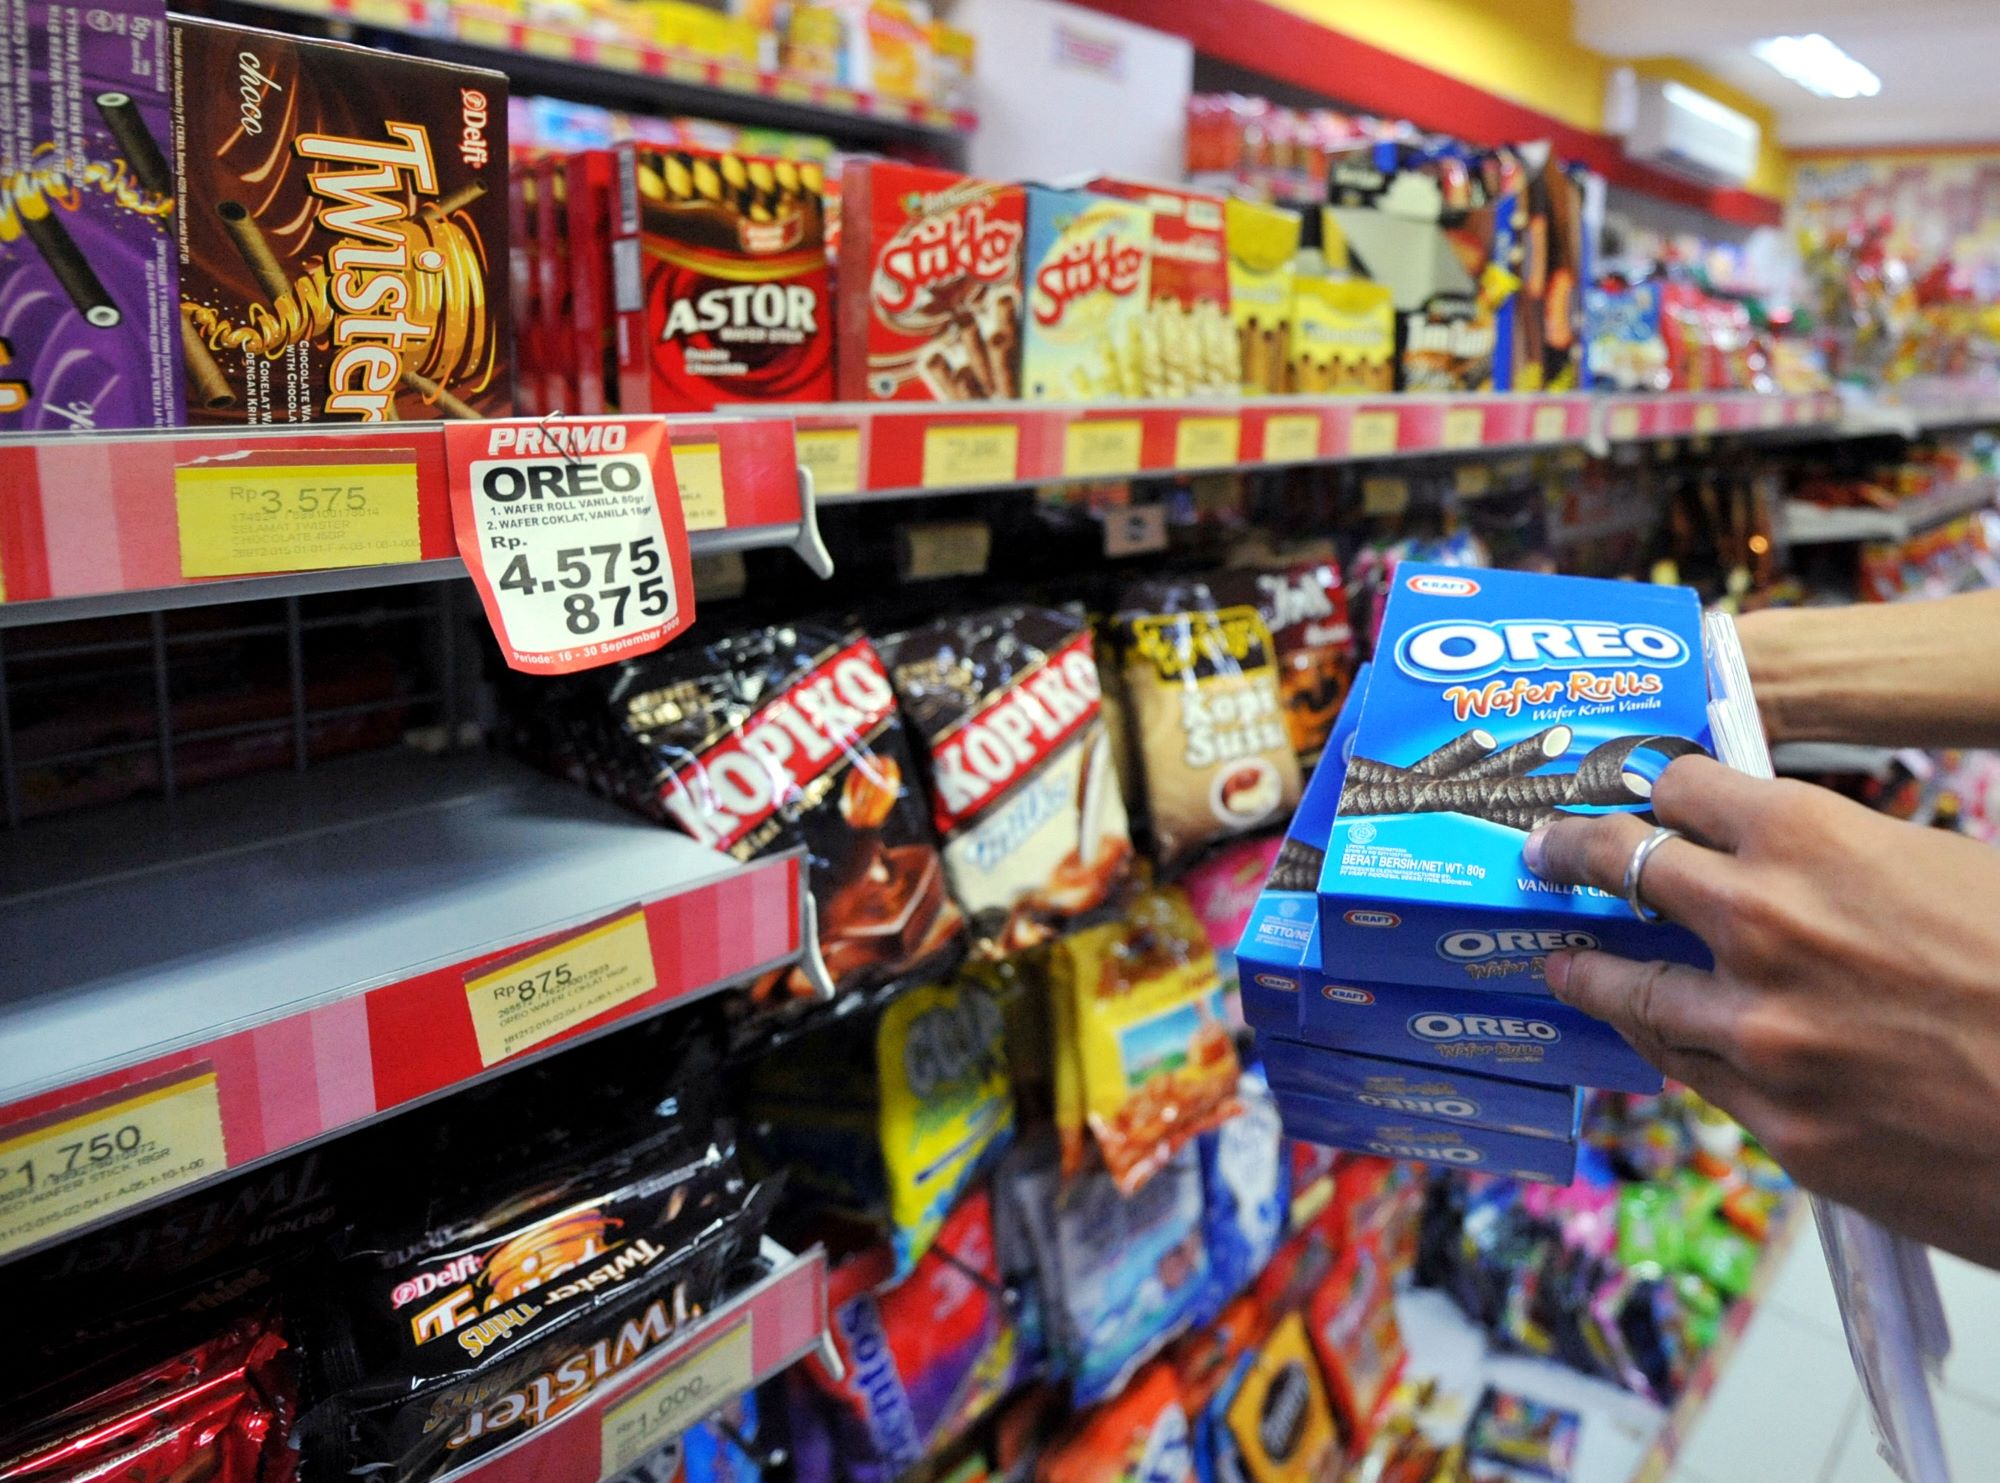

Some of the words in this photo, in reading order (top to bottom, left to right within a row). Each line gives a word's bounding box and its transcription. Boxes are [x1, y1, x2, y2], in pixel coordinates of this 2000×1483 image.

[239, 52, 282, 136] choco
[462, 108, 489, 166] Delfi
[294, 120, 439, 421] Twister
[663, 283, 817, 341] ASTOR
[287, 371, 298, 424] CHOCOLA
[488, 425, 627, 455] PROMO
[230, 486, 257, 503] Rp
[261, 486, 367, 514] 3.575
[483, 462, 641, 502] OREO
[500, 516, 539, 529] WAFER
[542, 513, 588, 526] COKLAT,
[591, 509, 628, 522] VANILA
[504, 501, 544, 515] WAFER
[547, 498, 576, 512] ROLL
[578, 494, 619, 509] VANILA
[491, 536, 528, 550] Rp.
[499, 536, 660, 595] 4.575
[564, 576, 668, 635] 875
[513, 651, 555, 665] Periode:
[583, 646, 598, 657] 30
[600, 630, 661, 655] September
[1408, 624, 1681, 672] OREO
[1443, 678, 1563, 721] Wafer
[1566, 671, 1663, 702] Rolls
[1532, 707, 1576, 723] Wafer
[1578, 702, 1615, 717] Krim
[1617, 698, 1662, 714] Vanila
[932, 651, 1101, 814] KOPIKO
[662, 658, 894, 848] KOPIKO
[1342, 853, 1377, 866] BERAT
[1445, 862, 1465, 875] WT:
[1466, 864, 1487, 879] 80g
[1516, 878, 1582, 896] VANILLA
[1355, 914, 1391, 925] KRAFT
[1444, 931, 1598, 959] OREO
[493, 984, 516, 1001] Rp
[518, 963, 573, 1003] 875
[1332, 988, 1364, 1001] KRAFT
[1412, 1014, 1558, 1040] OREO
[415, 1253, 482, 1294] Delfi
[544, 1238, 665, 1305] Twister
